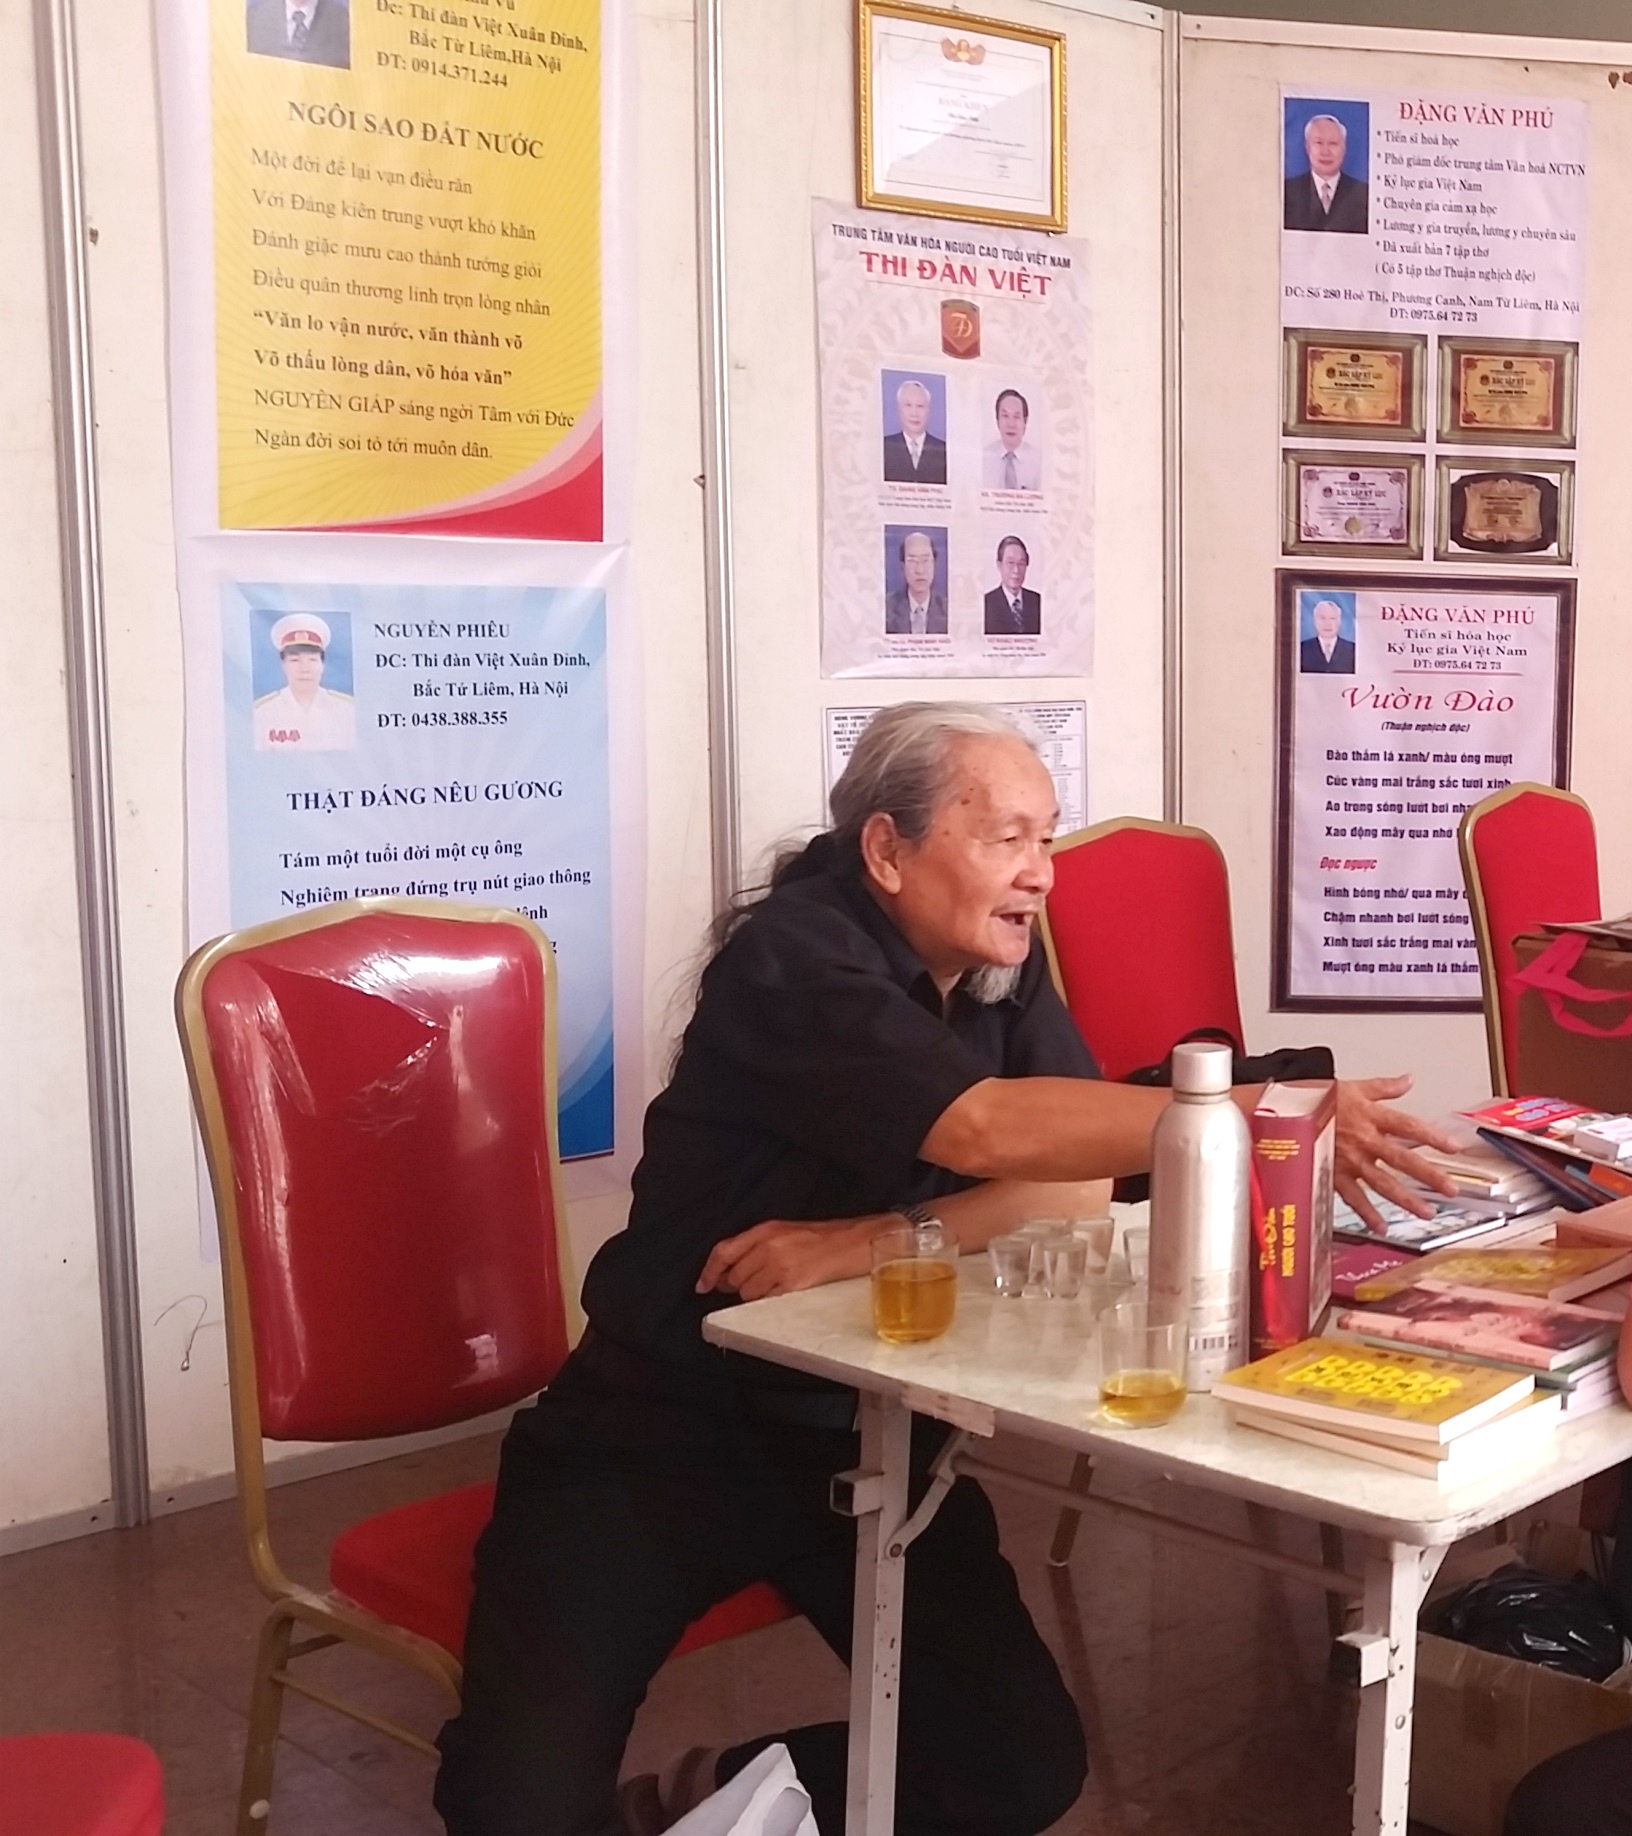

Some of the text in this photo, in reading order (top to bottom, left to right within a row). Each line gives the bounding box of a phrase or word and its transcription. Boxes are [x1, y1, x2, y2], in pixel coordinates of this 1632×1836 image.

[377, 51, 508, 87] ĐT: 0914.371.244
[1400, 99, 1553, 129] ĐẶNG VĂN PHÚ
[288, 102, 357, 130] NGÔI
[364, 114, 415, 139] SAO
[476, 131, 544, 159] NƯỚC
[859, 251, 1052, 298] THI ĐÀN VIỆT
[253, 267, 551, 316] Điều quân thương lính trọn lòng nhân
[308, 314, 324, 331] lo
[329, 317, 360, 337] vận
[366, 323, 414, 340] nước,
[418, 327, 448, 343] văn
[453, 329, 500, 347] thành
[504, 334, 523, 350] võ
[254, 349, 280, 367] Võ
[332, 356, 369, 378] lòng
[374, 360, 411, 378] dân,
[416, 364, 435, 379] võ
[440, 365, 469, 382] hóa
[348, 394, 395, 414] GIÁP
[399, 400, 435, 421] sáng
[439, 404, 473, 423] ngời
[478, 405, 512, 423] Tâm
[516, 409, 540, 425] với
[545, 410, 575, 428] Đức
[255, 429, 493, 458] Ngàn đời soi tỏ tới muôn dân.
[1381, 604, 1535, 625] ĐẶNG VĂN PHÚ
[376, 653, 407, 668] ĐC:
[412, 653, 438, 667] Thi
[443, 653, 471, 667] đàn
[475, 653, 505, 671] Việt
[509, 653, 548, 667] Xuân
[413, 679, 441, 697] Bắc
[472, 682, 515, 696] Liêm,
[519, 681, 540, 695] Hà
[544, 681, 568, 698] Nội
[1341, 684, 1514, 712] Vườn Đào
[378, 711, 508, 728] ĐT: 0438.388.355
[286, 781, 563, 813] THẬT ĐÁNG NÊU GƯƠNG
[279, 840, 523, 869] Tám một tuổi đời một cụ ông
[281, 887, 348, 908] Nghiêm
[406, 880, 449, 897] đứng
[454, 880, 477, 895] trụ
[483, 874, 509, 890] nút
[514, 873, 545, 891] giao
[549, 869, 591, 885] thông
